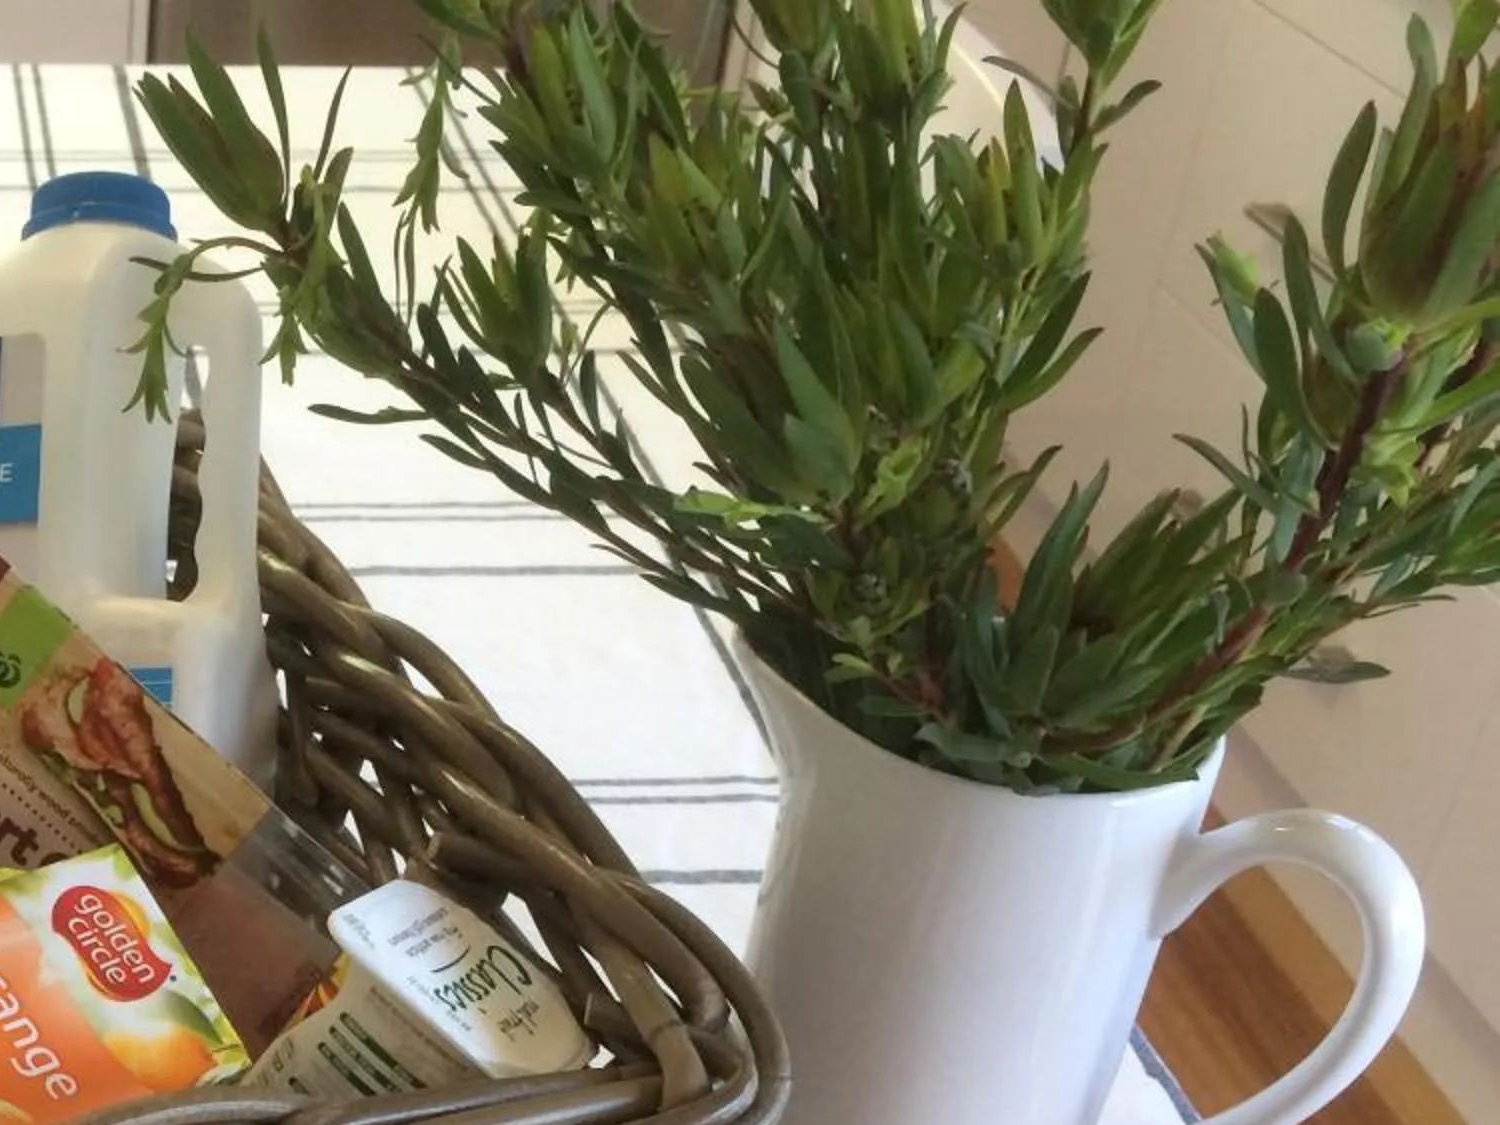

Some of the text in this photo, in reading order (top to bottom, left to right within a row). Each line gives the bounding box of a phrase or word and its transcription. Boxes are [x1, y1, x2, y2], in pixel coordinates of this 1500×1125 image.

[67, 917, 127, 985] circle
[73, 893, 156, 984] golden
[432, 944, 533, 1015] Classics
